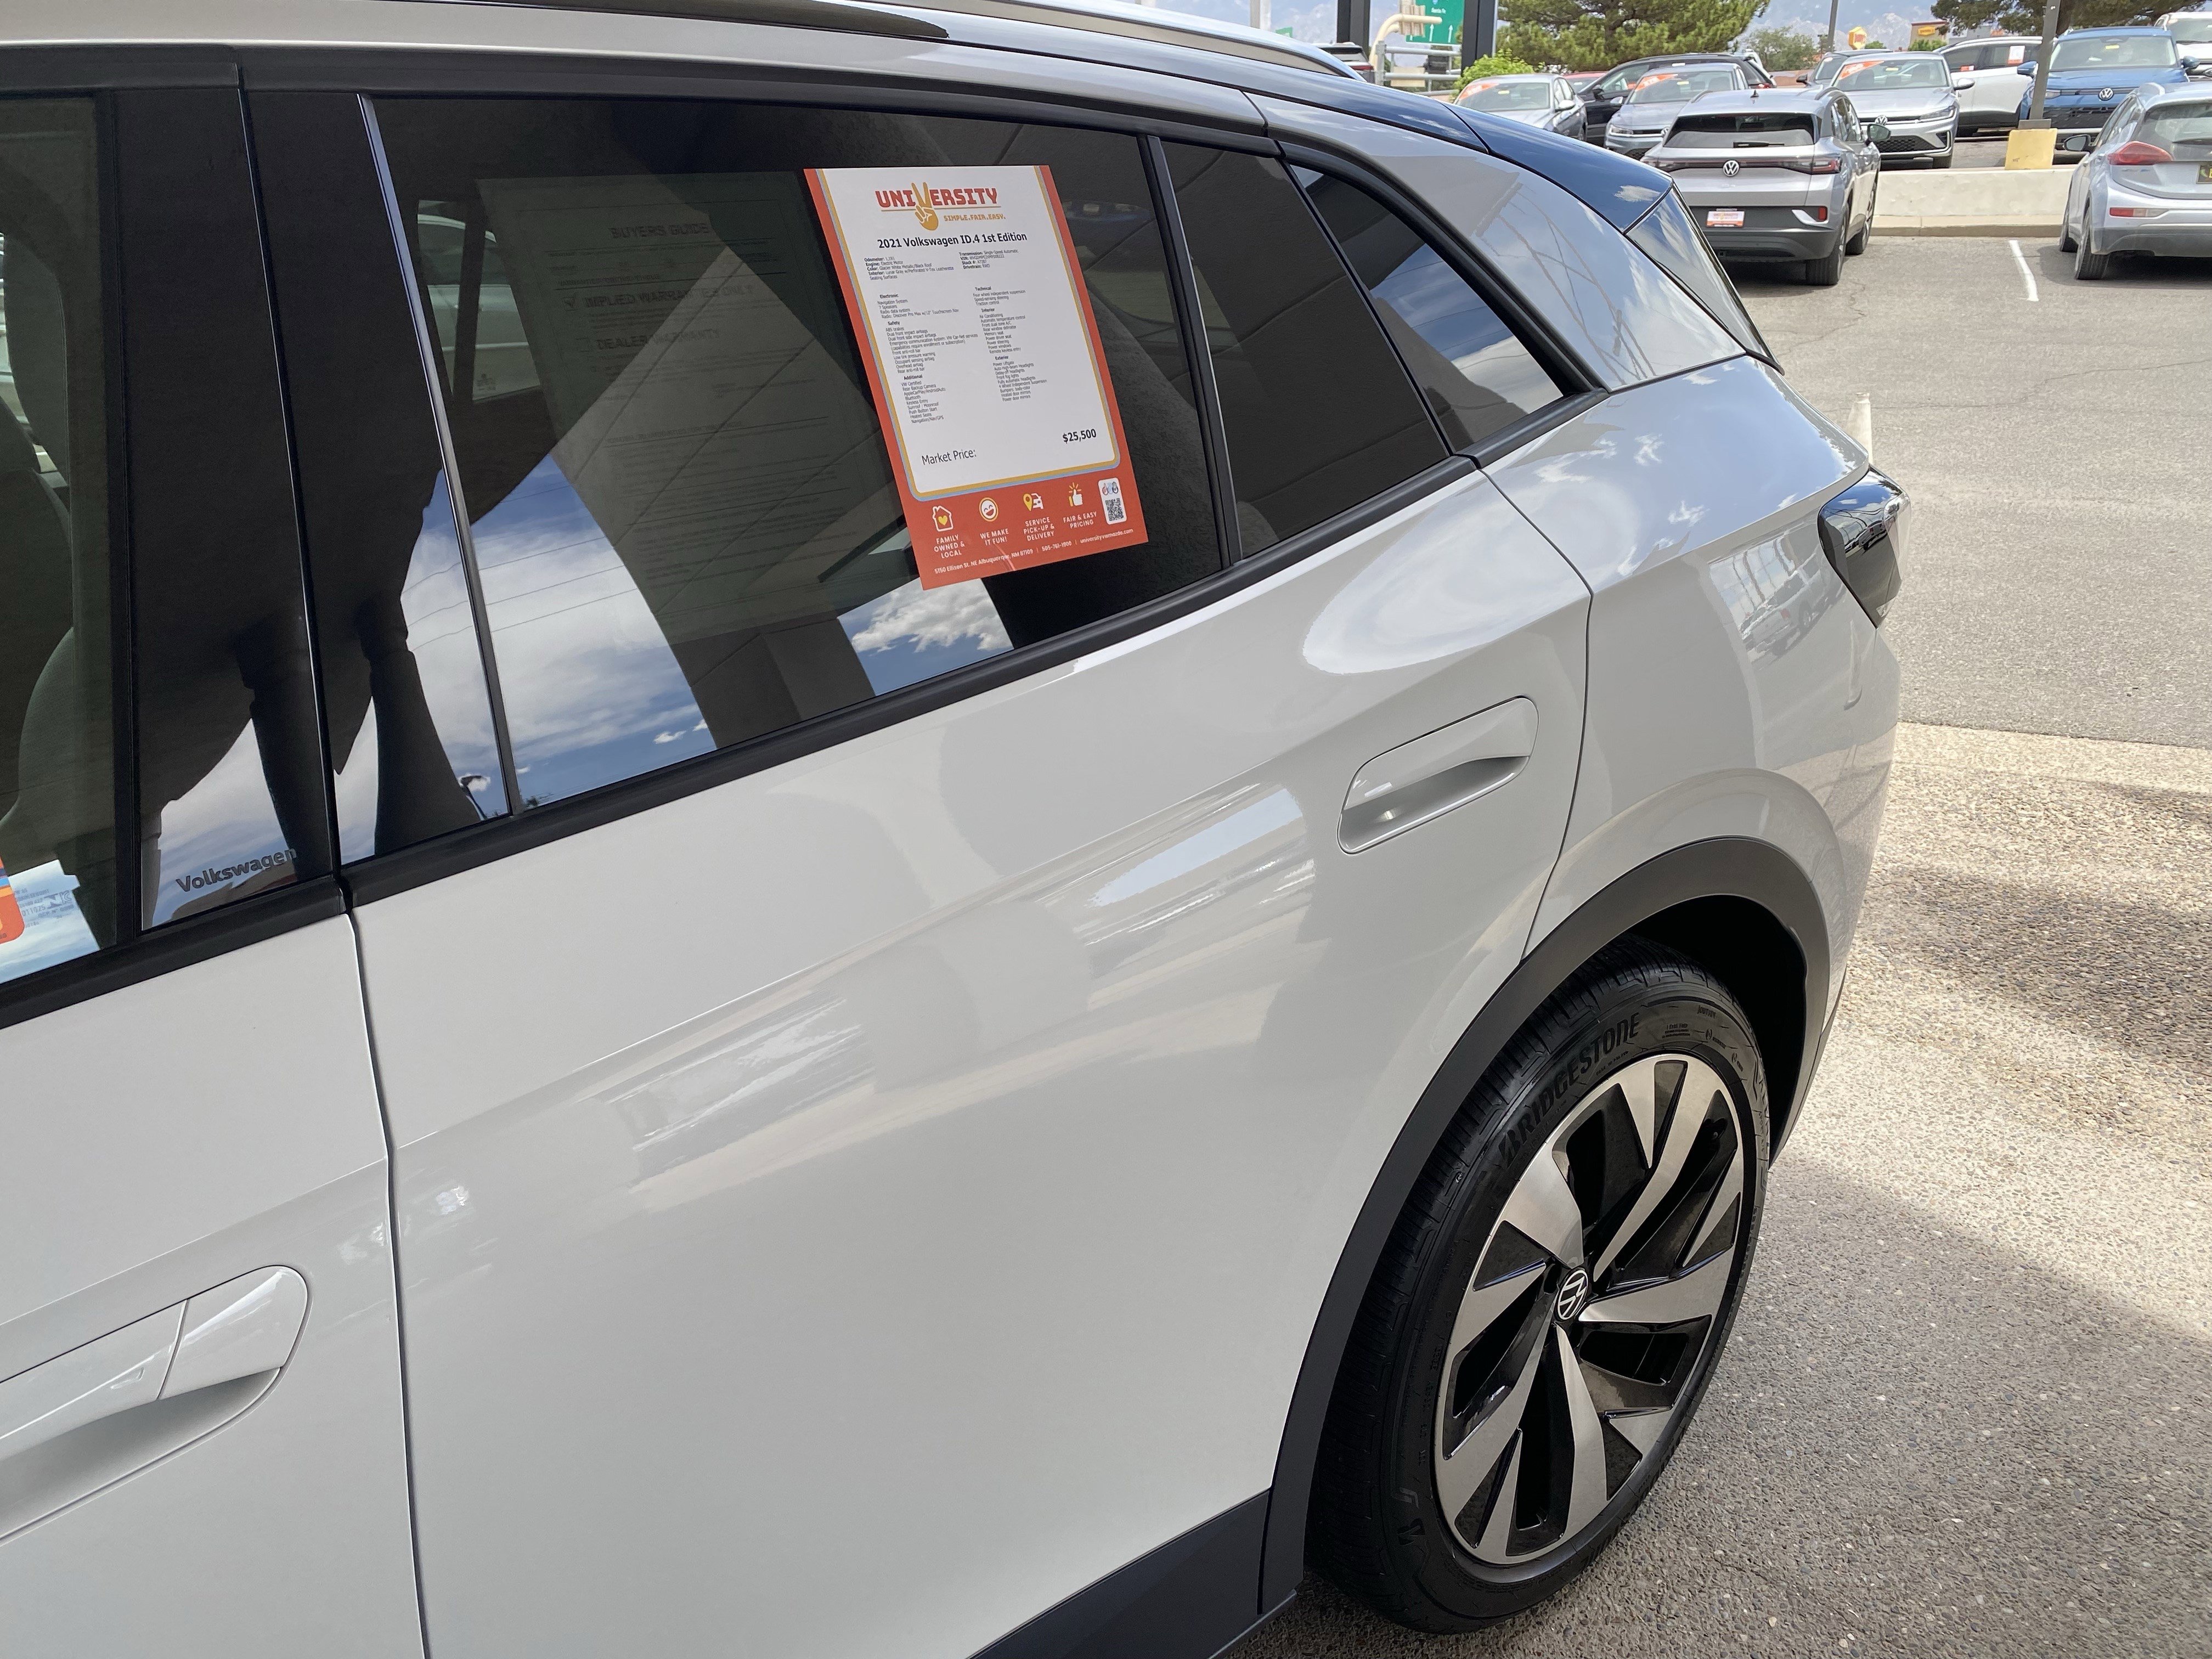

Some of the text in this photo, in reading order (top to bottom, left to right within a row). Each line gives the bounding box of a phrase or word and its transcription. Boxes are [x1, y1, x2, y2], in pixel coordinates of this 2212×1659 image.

[874, 188, 1000, 207] UNIVERSITY
[877, 232, 1028, 249] 2021 Volkswagen ID.4 1st Edition
[1062, 428, 1098, 444] $25,500
[921, 447, 977, 465] Market Price:
[1024, 516, 1051, 527] SERVICE
[1062, 515, 1077, 523] FAIR
[1083, 511, 1097, 520] EASY
[1069, 518, 1094, 529] PRICING
[991, 528, 1009, 537] MAKE
[1023, 524, 1049, 535] PICK-UP
[935, 534, 960, 545] FAMILY
[992, 536, 1007, 544] FUN!
[1026, 530, 1054, 541] DELIVERY
[933, 542, 960, 553] OWNED
[940, 549, 962, 558] LOCAL
[946, 562, 963, 572] Ellison
[176, 848, 297, 893] Volkswagen
[1498, 1011, 1640, 1169] BRIDGESTONE
